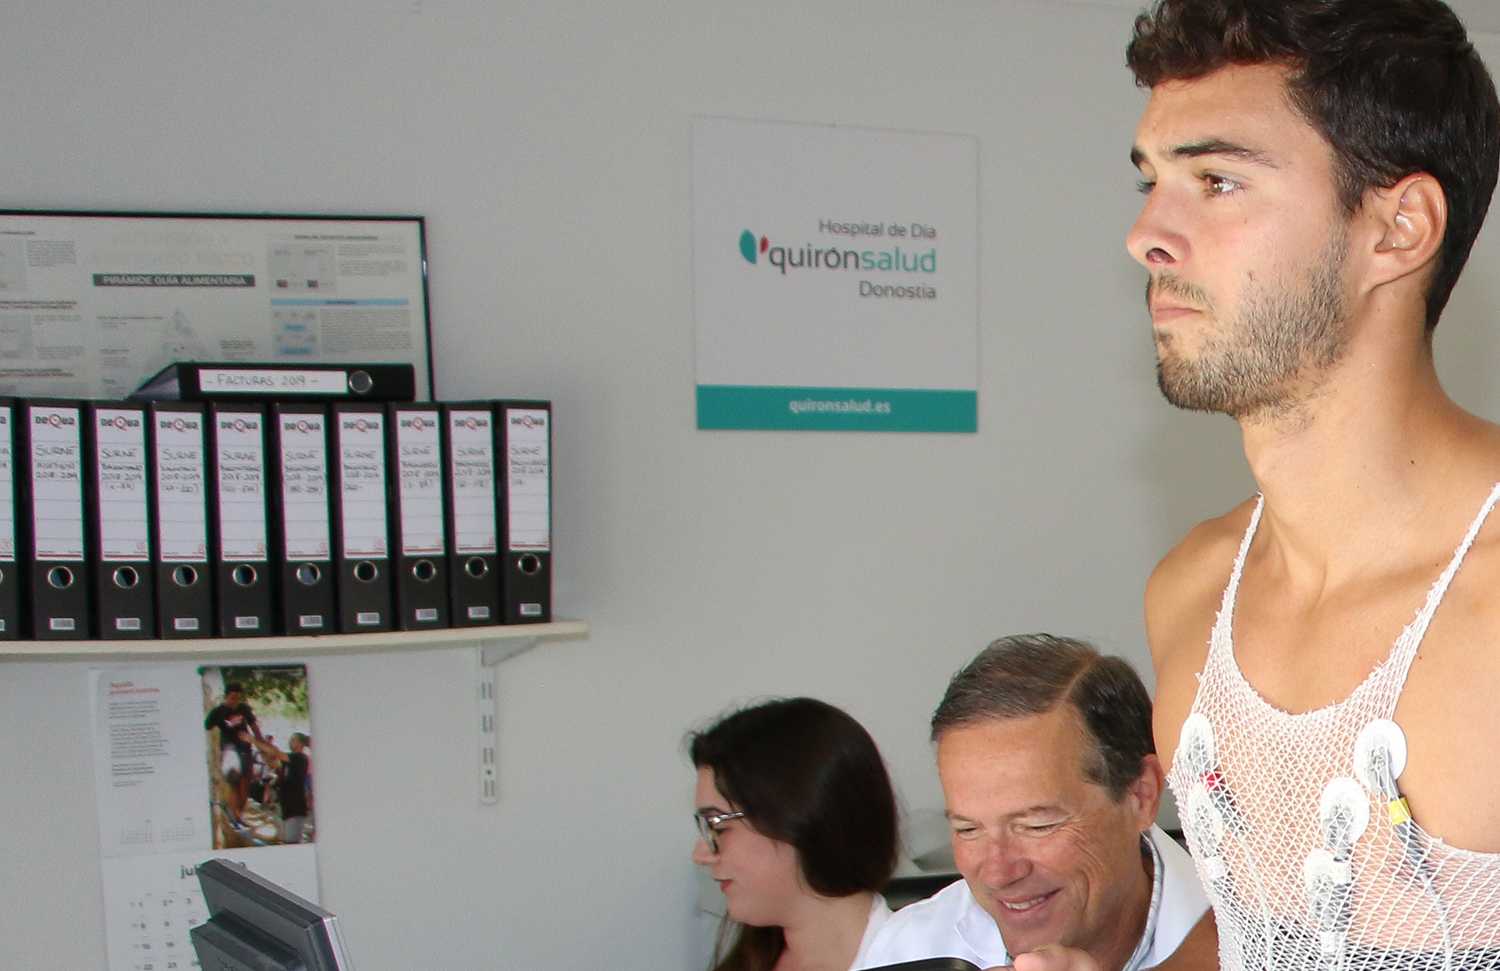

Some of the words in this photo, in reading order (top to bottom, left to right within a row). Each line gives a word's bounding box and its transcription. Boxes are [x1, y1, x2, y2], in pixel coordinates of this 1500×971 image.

[818, 219, 884, 237] Hospital
[887, 223, 906, 237] de
[859, 280, 937, 299] Donostia
[789, 398, 891, 414] quironsalud.es
